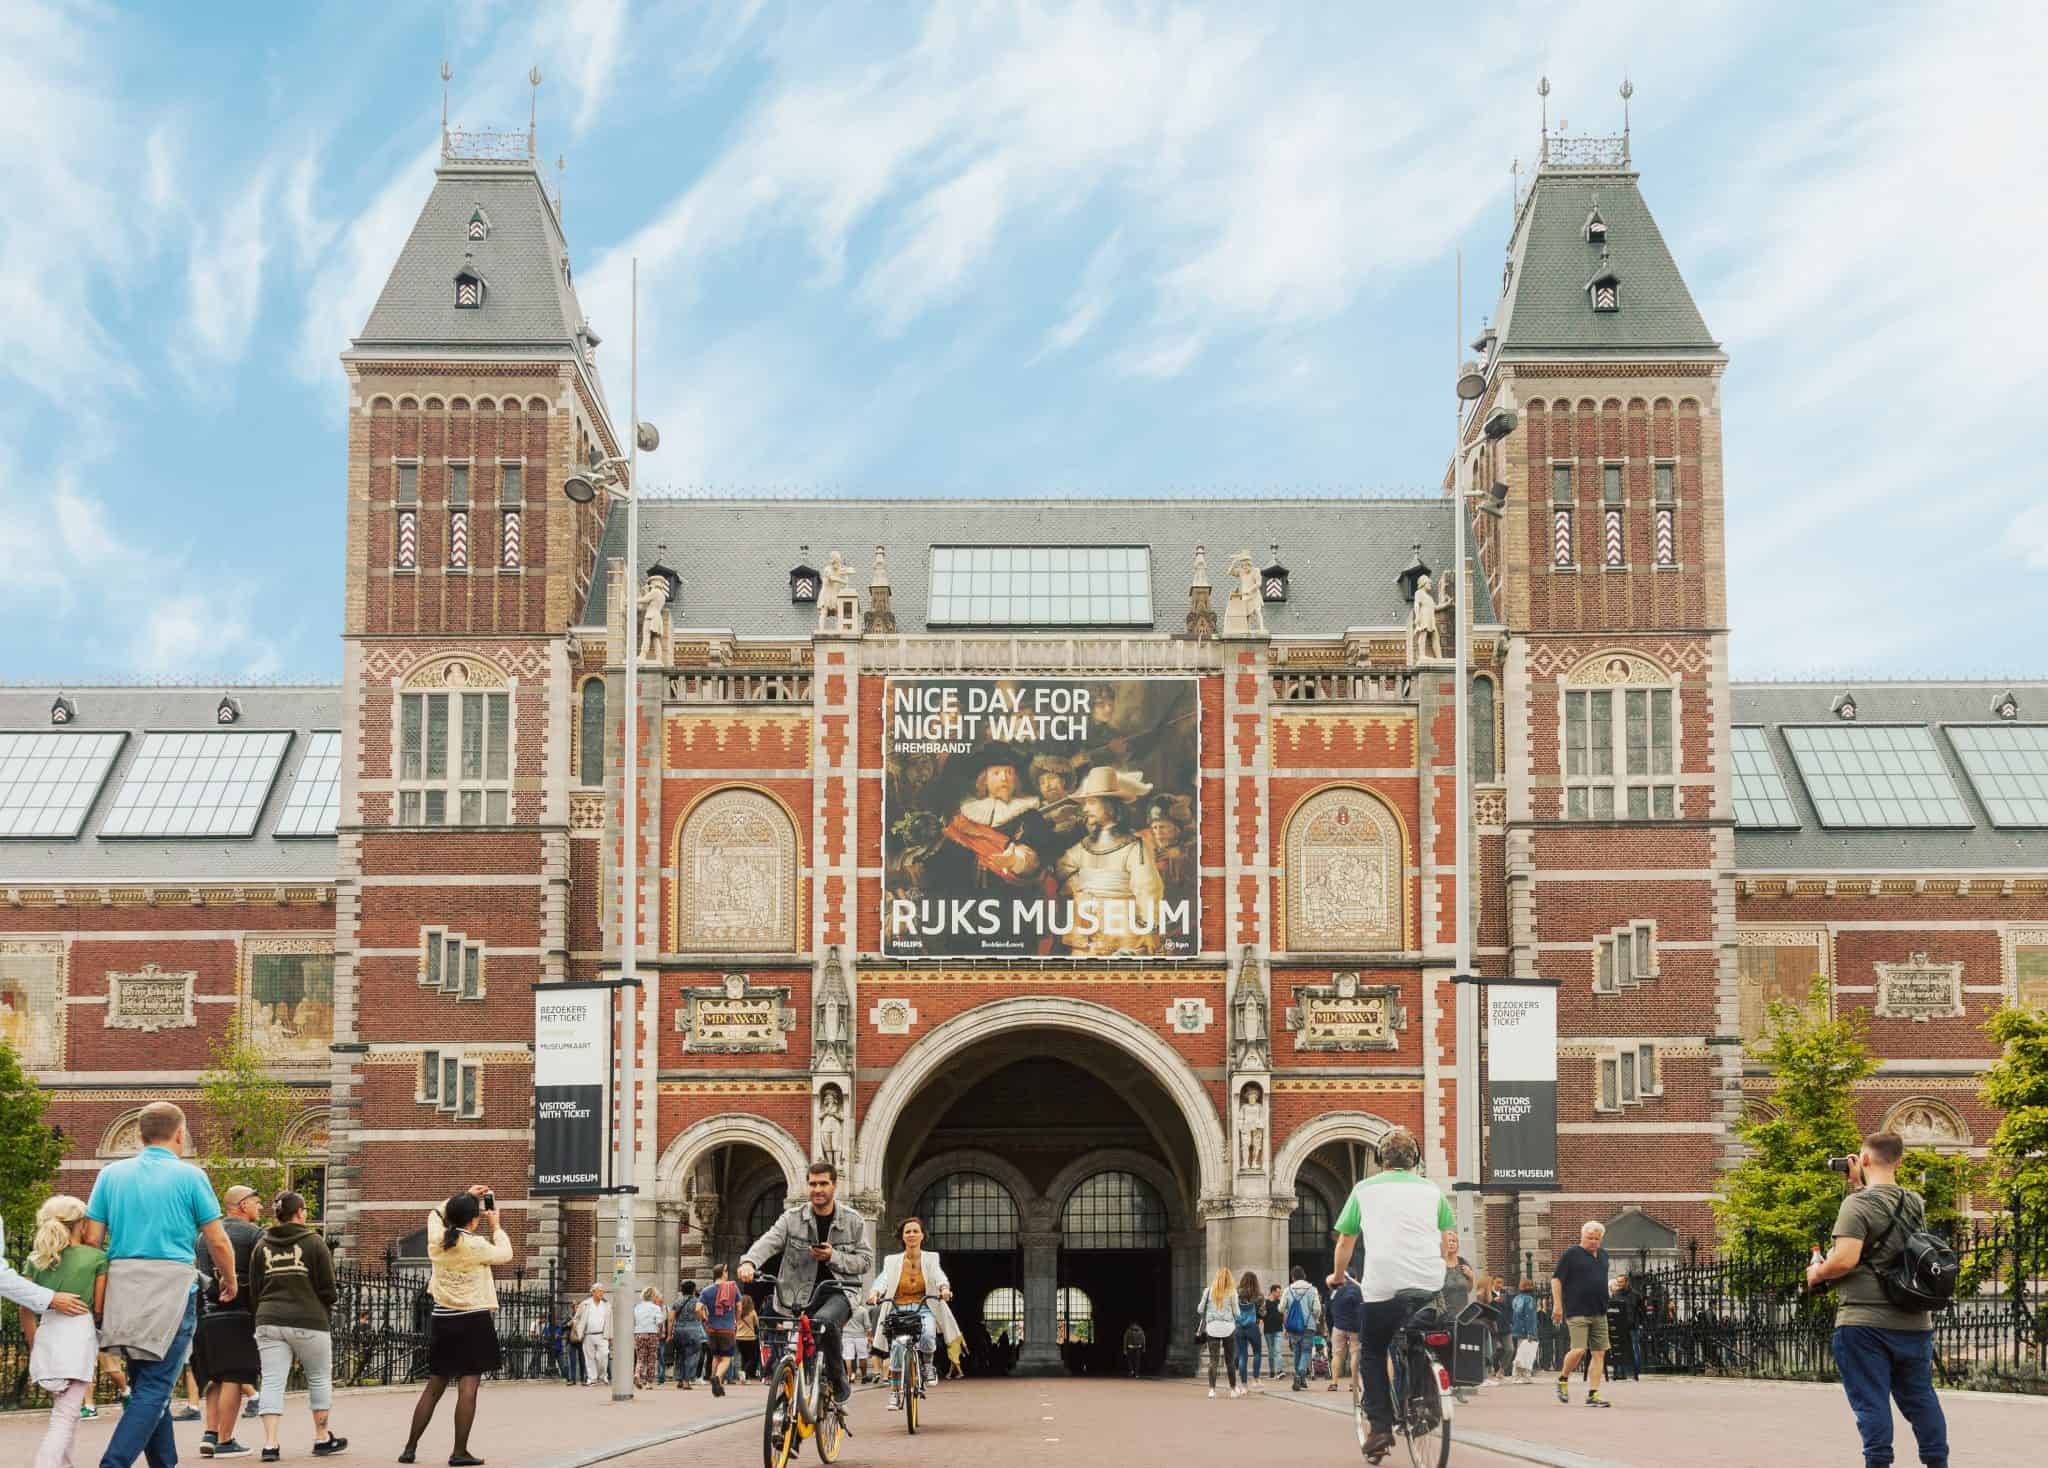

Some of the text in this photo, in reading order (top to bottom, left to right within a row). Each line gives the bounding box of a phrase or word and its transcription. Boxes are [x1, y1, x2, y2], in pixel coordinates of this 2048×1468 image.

[894, 687, 1091, 714] NICE DAY FOR
[894, 714, 1088, 741] NIGHT WATCH
[894, 743, 972, 754] #REMBRANDT
[1012, 899, 1190, 936] MUSEUM
[1492, 1001, 1541, 1009] BEZOEKERS
[1492, 1009, 1526, 1017] ZONDER
[560, 1014, 586, 1022] TICKET
[1492, 1017, 1520, 1026] TICKET
[1493, 1096, 1531, 1105] VISITORS
[539, 1101, 577, 1110] VISITORS
[1493, 1105, 1532, 1113] WITHOUT
[539, 1109, 591, 1119] WITH TICKET
[1493, 1113, 1521, 1122] TICKET
[1517, 1168, 1554, 1177] MUSEUM
[562, 1173, 599, 1183] MUSEUM
